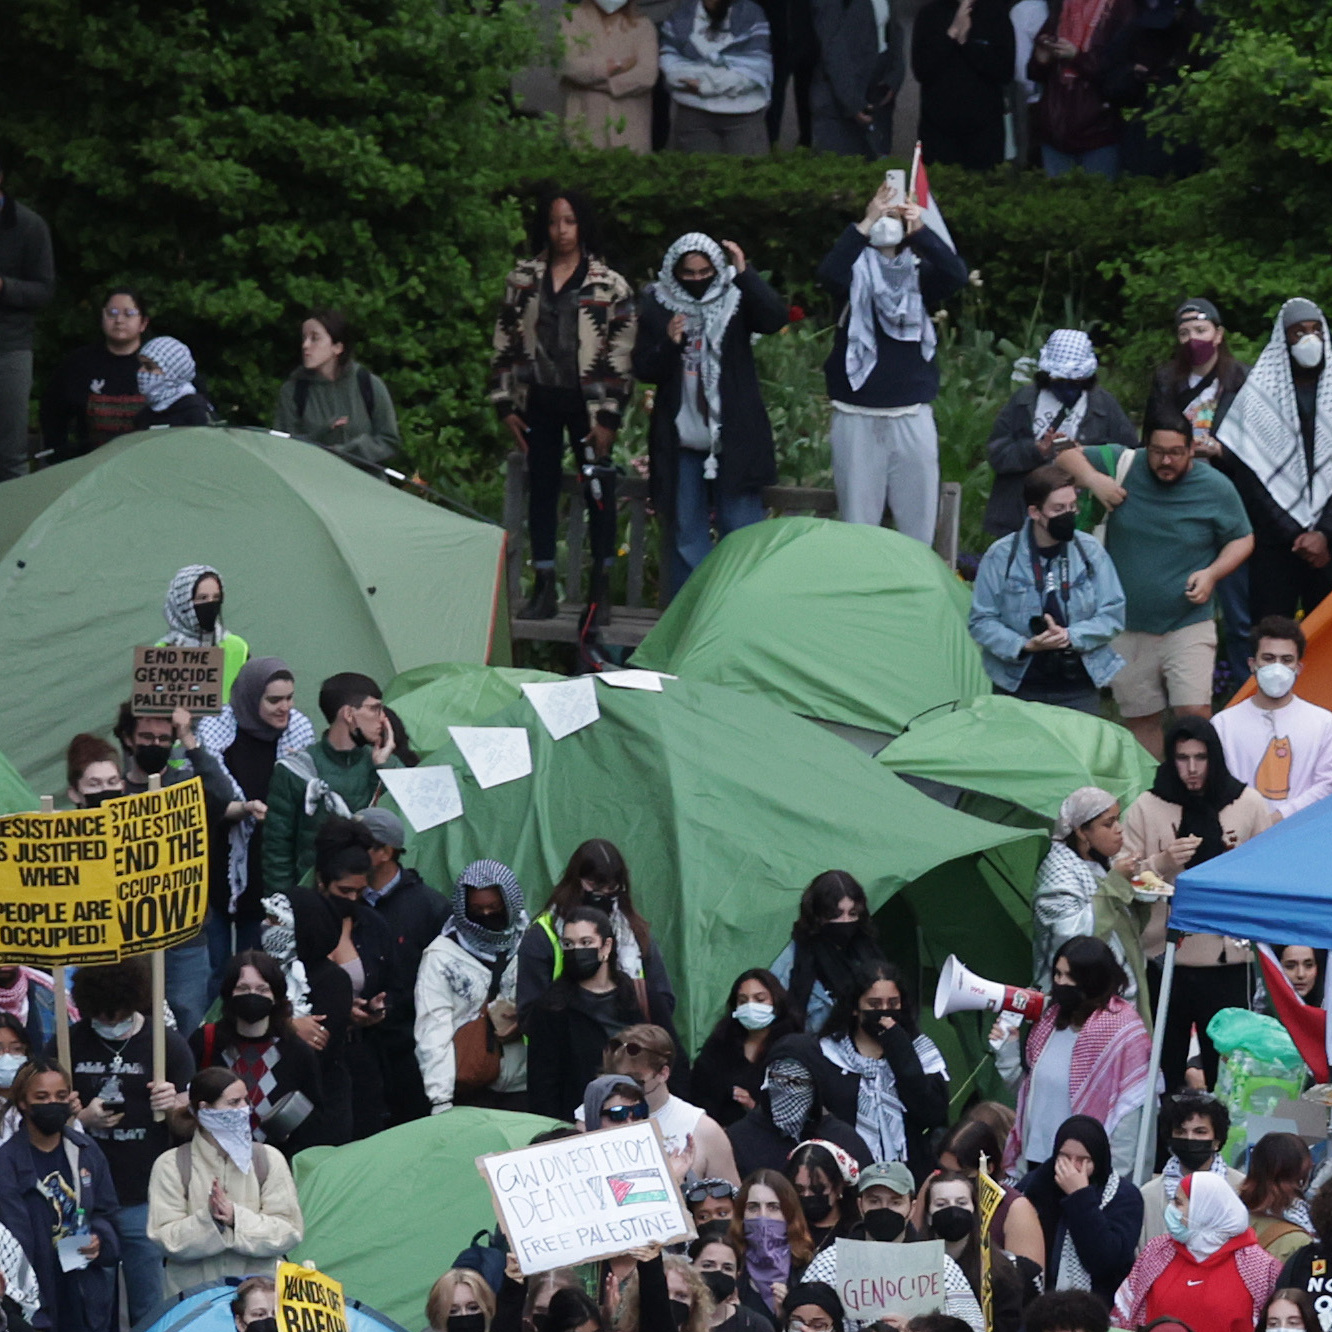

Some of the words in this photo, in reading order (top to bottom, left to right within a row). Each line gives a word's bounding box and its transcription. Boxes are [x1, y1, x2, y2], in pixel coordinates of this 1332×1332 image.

[143, 650, 178, 665] END
[182, 651, 210, 665] THE
[134, 667, 219, 683] GENOCIDE
[134, 694, 217, 708] PALESTINE
[13, 839, 107, 863] JUSTIFIED
[166, 828, 203, 862] THE
[18, 866, 80, 888] WHEN
[73, 899, 112, 922] ARE
[0, 923, 106, 949] OCCUPIED!
[544, 1147, 600, 1184] DIVEST
[600, 1135, 658, 1167] FROM
[519, 1229, 572, 1264] FREE
[577, 1212, 678, 1250] PALESTINE
